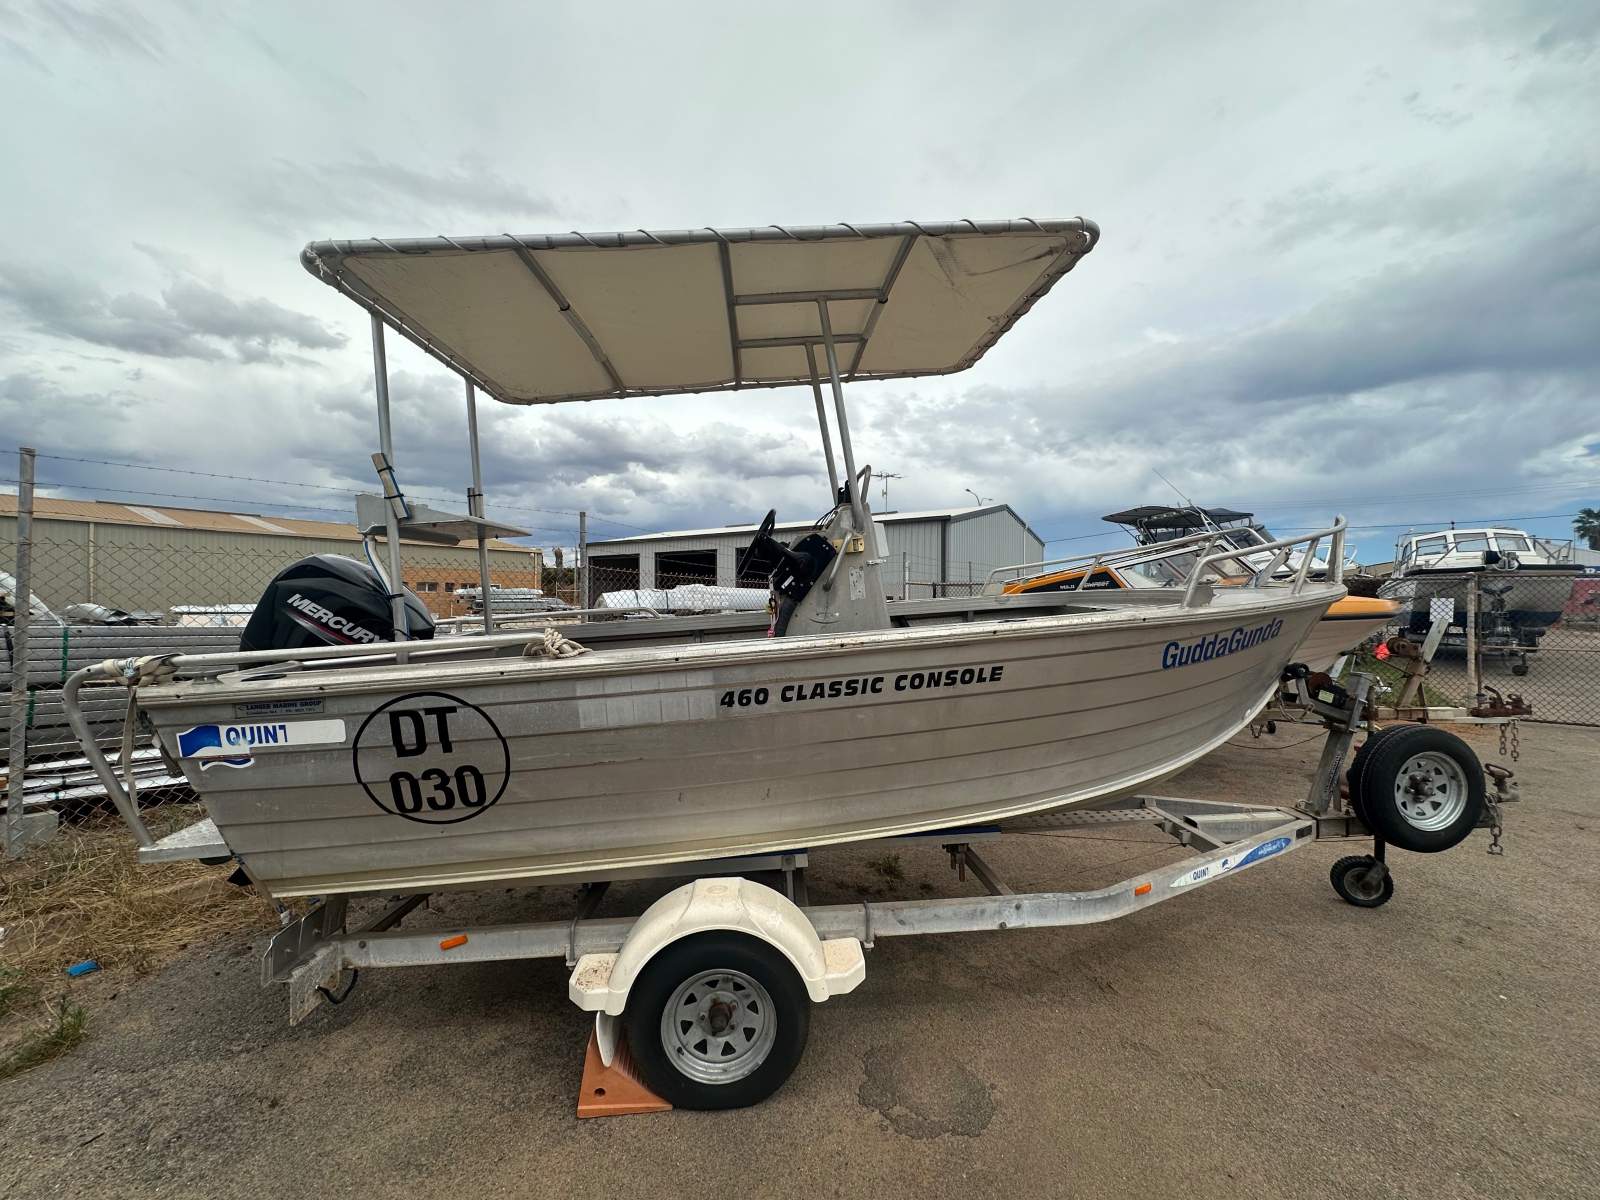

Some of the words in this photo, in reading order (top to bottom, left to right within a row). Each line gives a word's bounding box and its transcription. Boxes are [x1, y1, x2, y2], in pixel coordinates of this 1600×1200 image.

[1162, 617, 1284, 670] GuddaGunda
[720, 687, 769, 708] 460
[780, 676, 885, 703] CLASSIC
[894, 665, 1004, 692] CONSOLE
[389, 706, 458, 758] DT
[389, 765, 487, 814] 030
